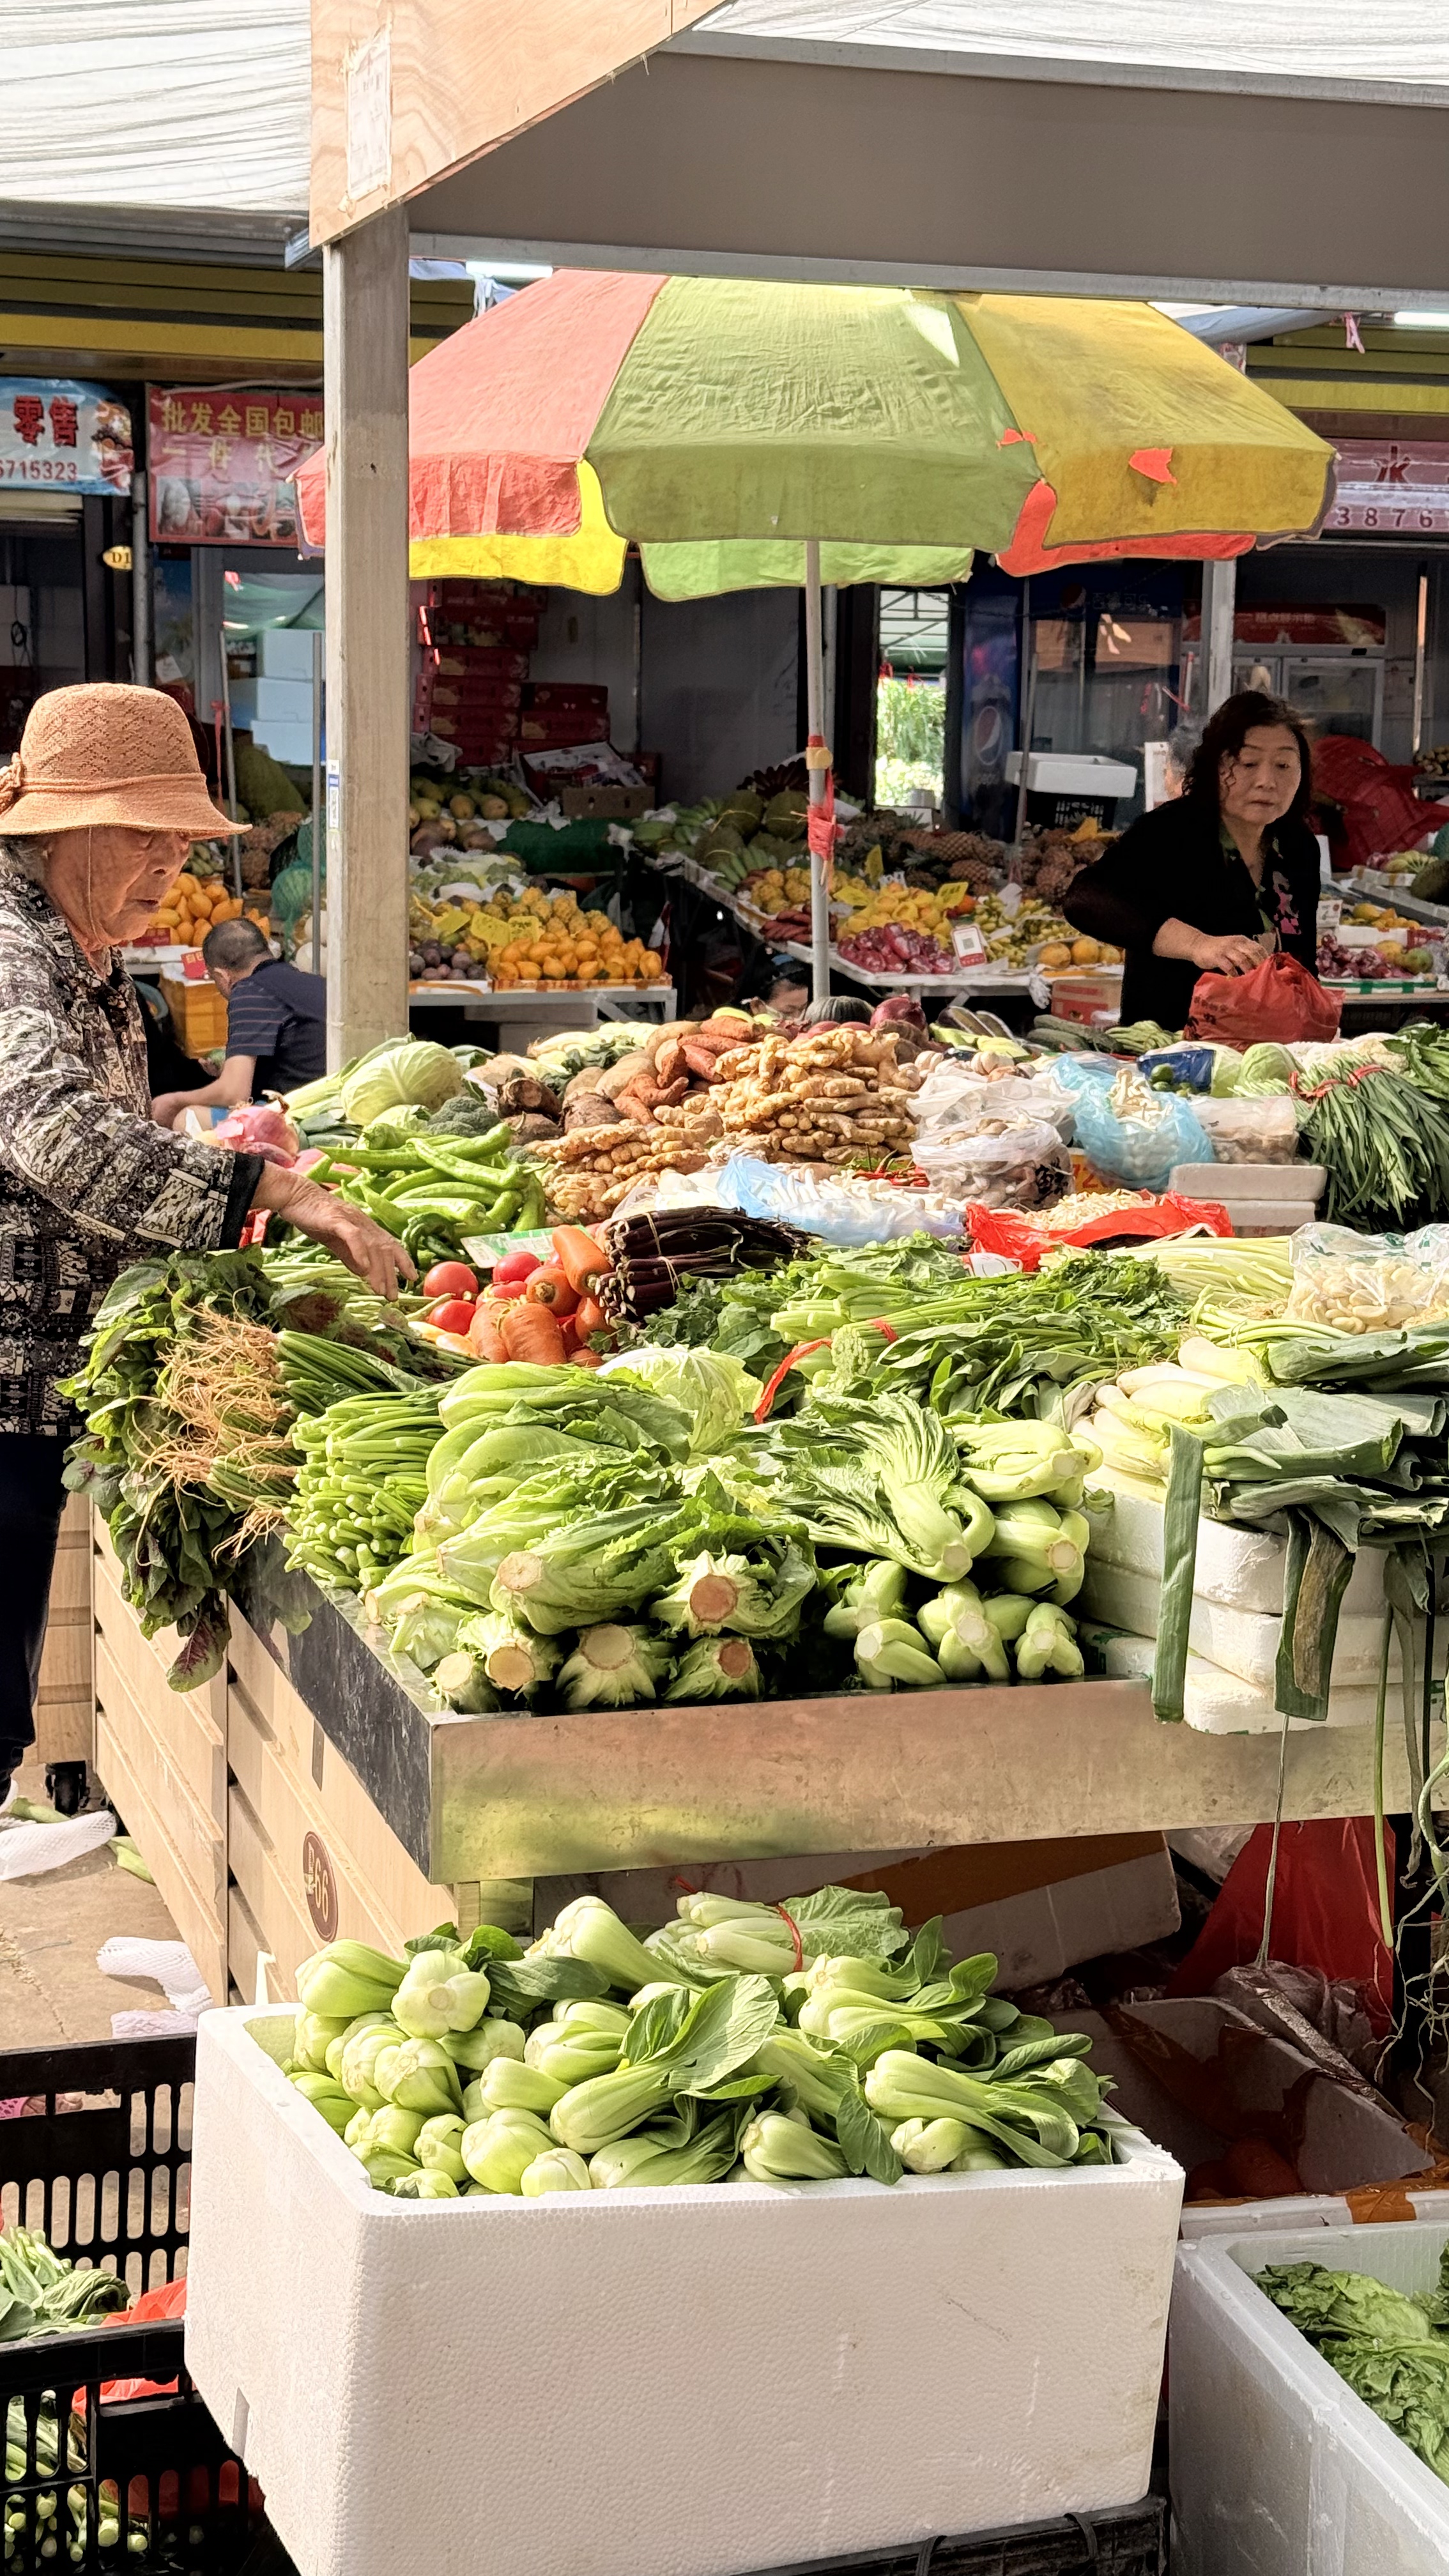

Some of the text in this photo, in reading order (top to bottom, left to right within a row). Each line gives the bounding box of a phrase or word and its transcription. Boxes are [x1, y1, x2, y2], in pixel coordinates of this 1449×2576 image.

[14, 395, 79, 447] 零售
[162, 401, 324, 440] 批发全国包邮
[1337, 507, 1433, 528] 3876
[314, 1857, 330, 1923] 66
